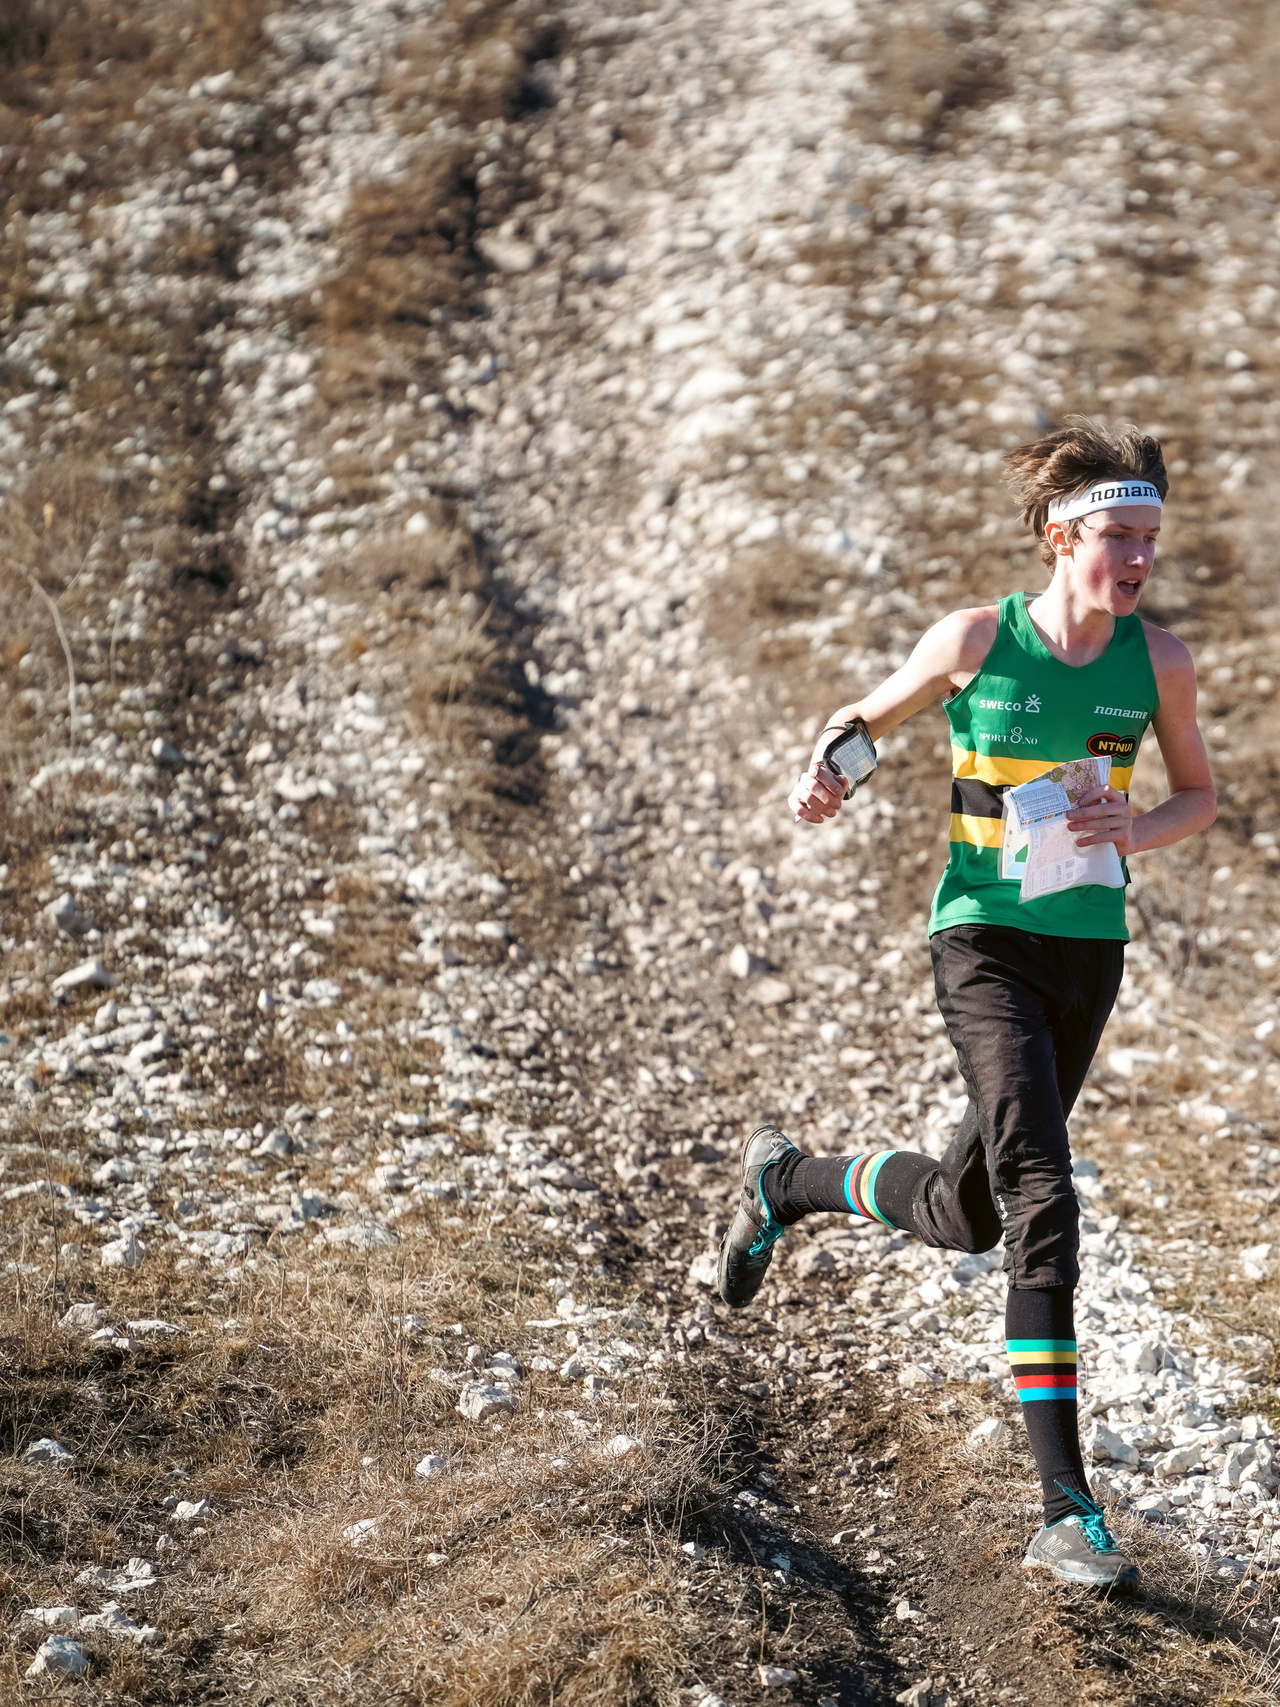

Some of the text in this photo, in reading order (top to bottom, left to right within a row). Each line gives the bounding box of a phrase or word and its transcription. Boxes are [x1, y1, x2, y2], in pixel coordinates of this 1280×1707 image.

[979, 699, 1022, 711] SWECO
[1093, 705, 1149, 720] noname
[1098, 740, 1133, 753] NTNUI
